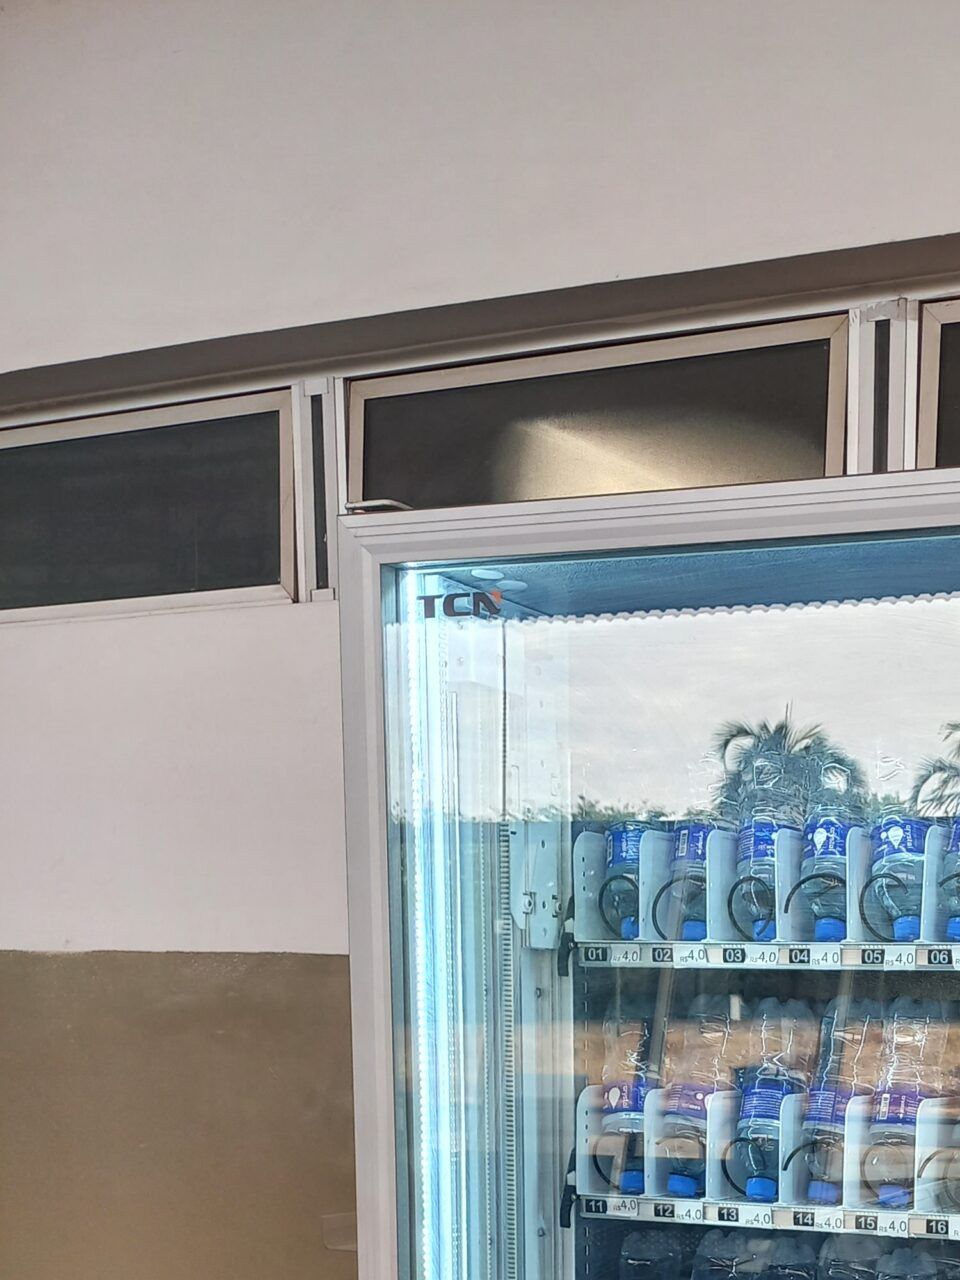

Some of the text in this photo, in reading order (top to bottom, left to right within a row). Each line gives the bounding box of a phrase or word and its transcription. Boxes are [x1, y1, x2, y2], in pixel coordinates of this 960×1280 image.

[417, 590, 501, 618] TCN
[587, 949, 604, 961] 01
[655, 949, 673, 962] 02
[725, 949, 743, 962] 03
[791, 950, 809, 963] 04
[864, 950, 882, 963] 05
[930, 950, 949, 964] 06
[588, 1200, 604, 1213] 11
[656, 1204, 673, 1217] 12
[720, 1208, 737, 1221] 13
[795, 1213, 814, 1226] 14
[857, 1216, 876, 1230] 15
[928, 1220, 947, 1234] 16
